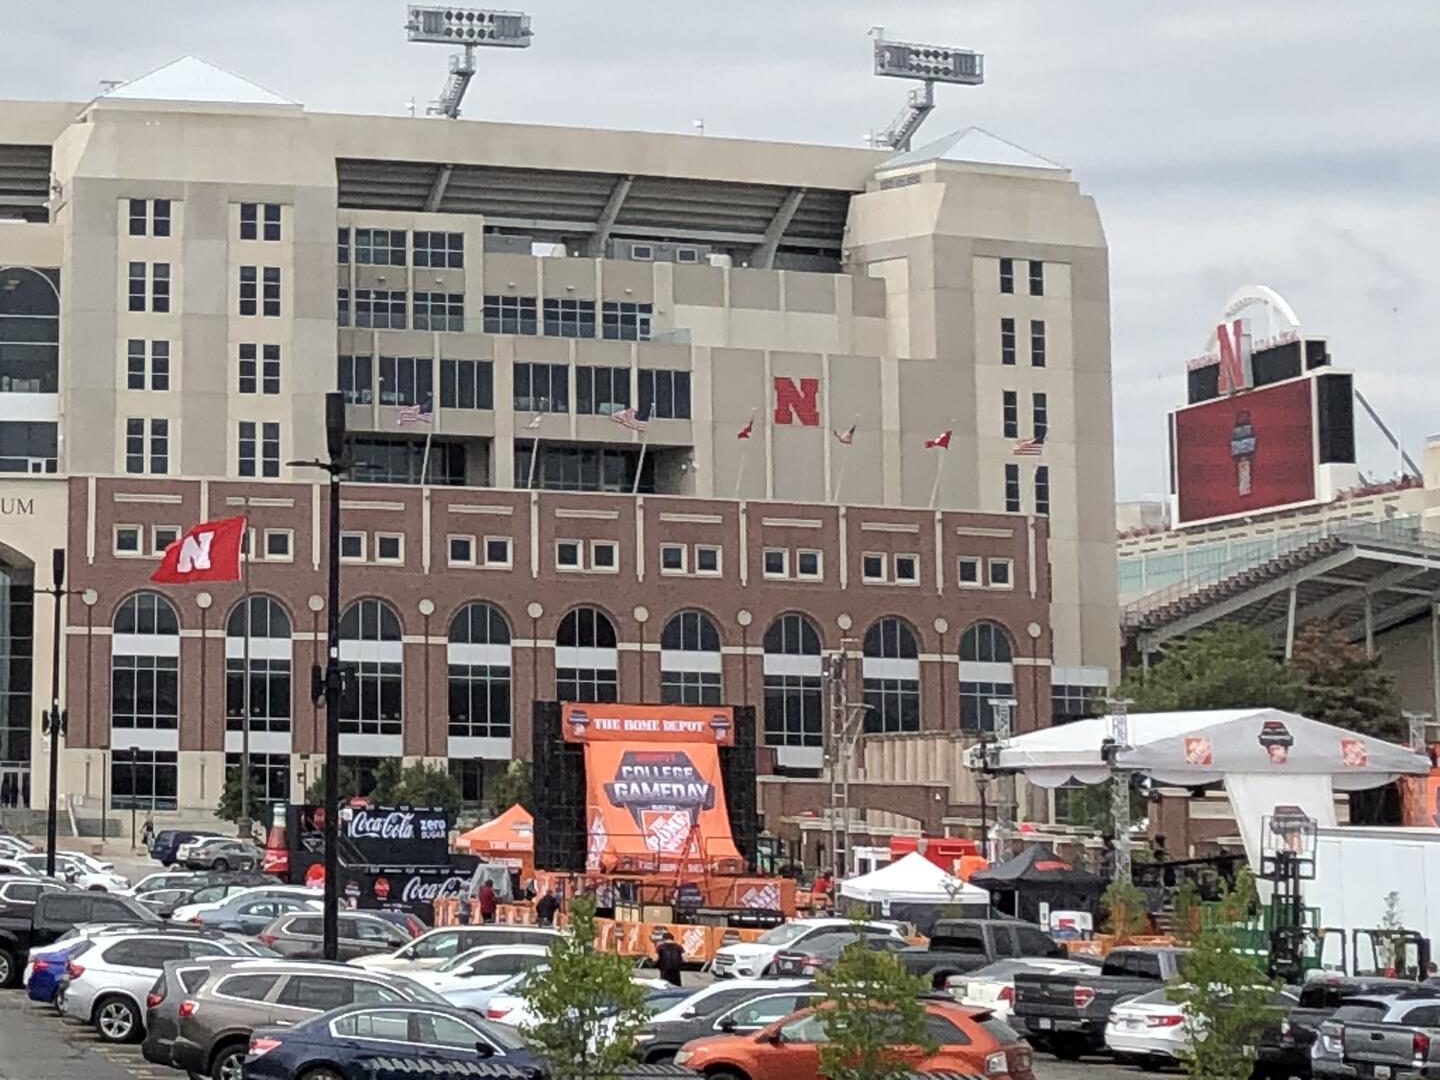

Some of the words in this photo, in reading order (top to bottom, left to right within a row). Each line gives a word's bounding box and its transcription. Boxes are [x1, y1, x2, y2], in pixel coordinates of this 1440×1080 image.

[1217, 319, 1249, 395] N
[774, 377, 819, 426] N
[177, 531, 215, 573] N
[594, 718, 621, 731] THE
[623, 719, 660, 732] HOME
[663, 720, 705, 733] DEPOT
[621, 765, 694, 780] COLLEGE
[614, 781, 709, 801] GAMEDAY
[420, 819, 447, 831] zero
